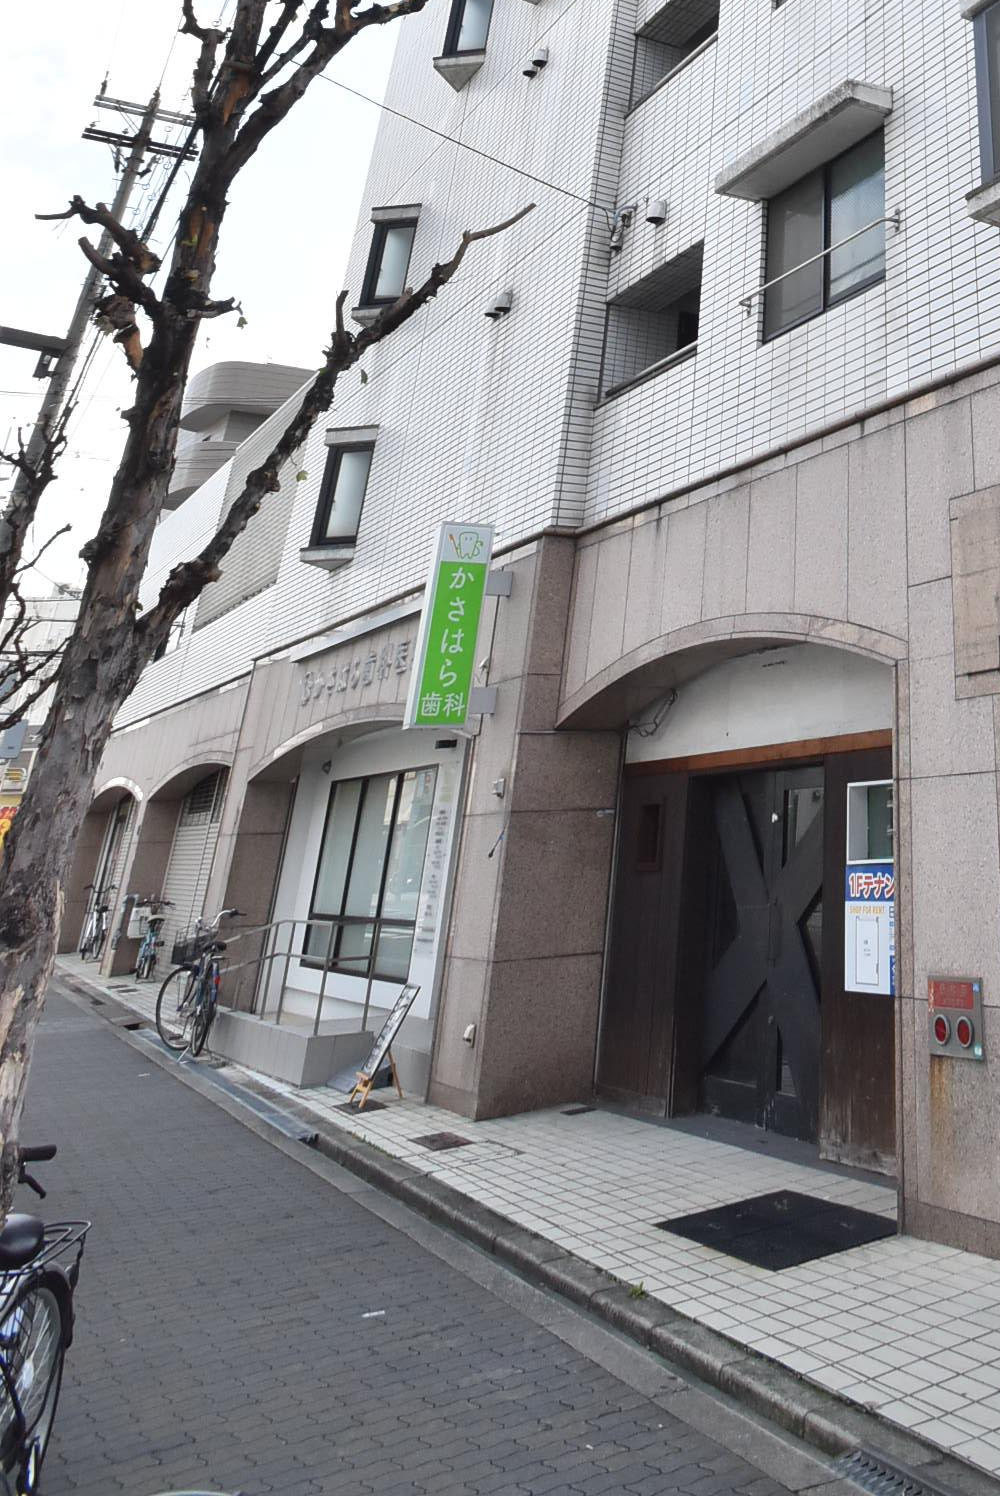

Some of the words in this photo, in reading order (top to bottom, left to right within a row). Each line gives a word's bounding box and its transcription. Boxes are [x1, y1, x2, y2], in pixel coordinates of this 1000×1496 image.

[438, 567, 475, 688] かさはら
[420, 691, 466, 718] 歯科
